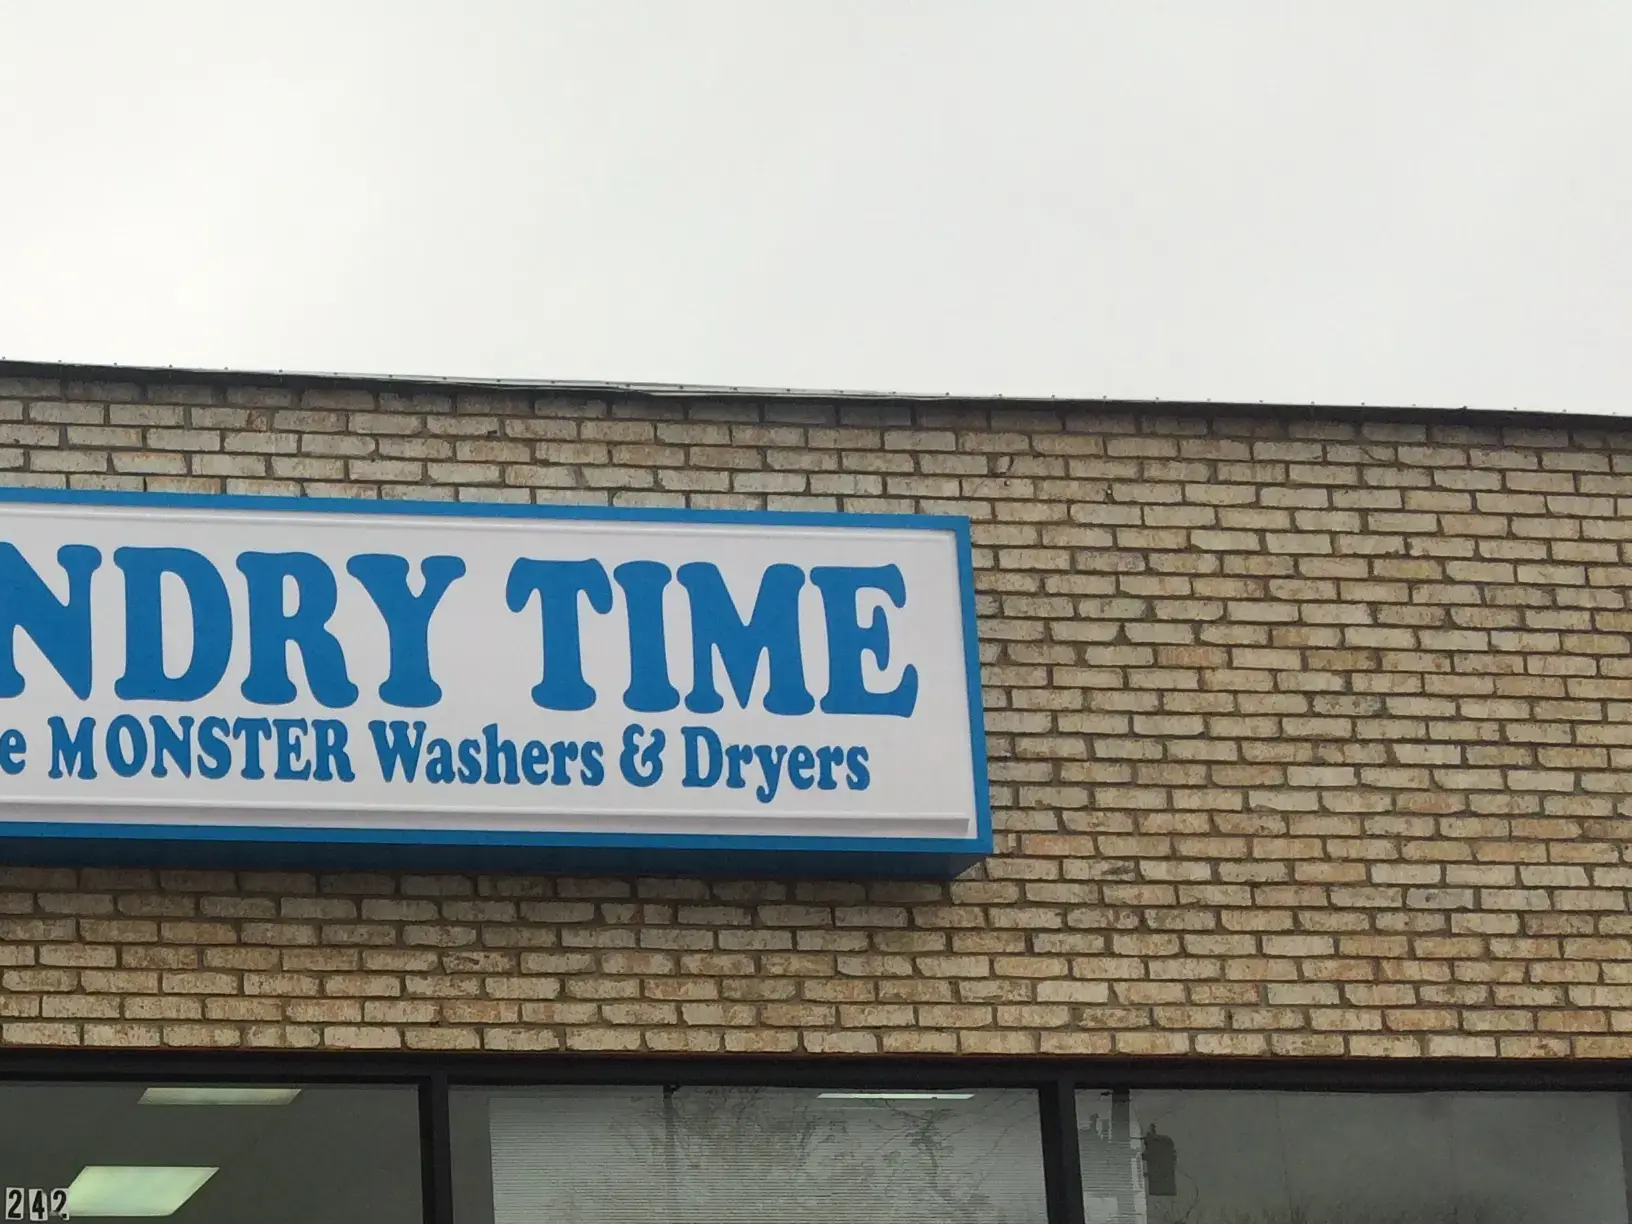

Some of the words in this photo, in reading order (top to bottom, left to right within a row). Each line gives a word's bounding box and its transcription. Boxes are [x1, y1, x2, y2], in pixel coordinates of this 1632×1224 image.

[506, 557, 919, 718] TIME
[48, 714, 356, 780] MONSTER
[368, 719, 605, 786] Washers
[619, 723, 666, 787] &
[682, 725, 870, 803] Dryers
[6, 1188, 67, 1220] 242
